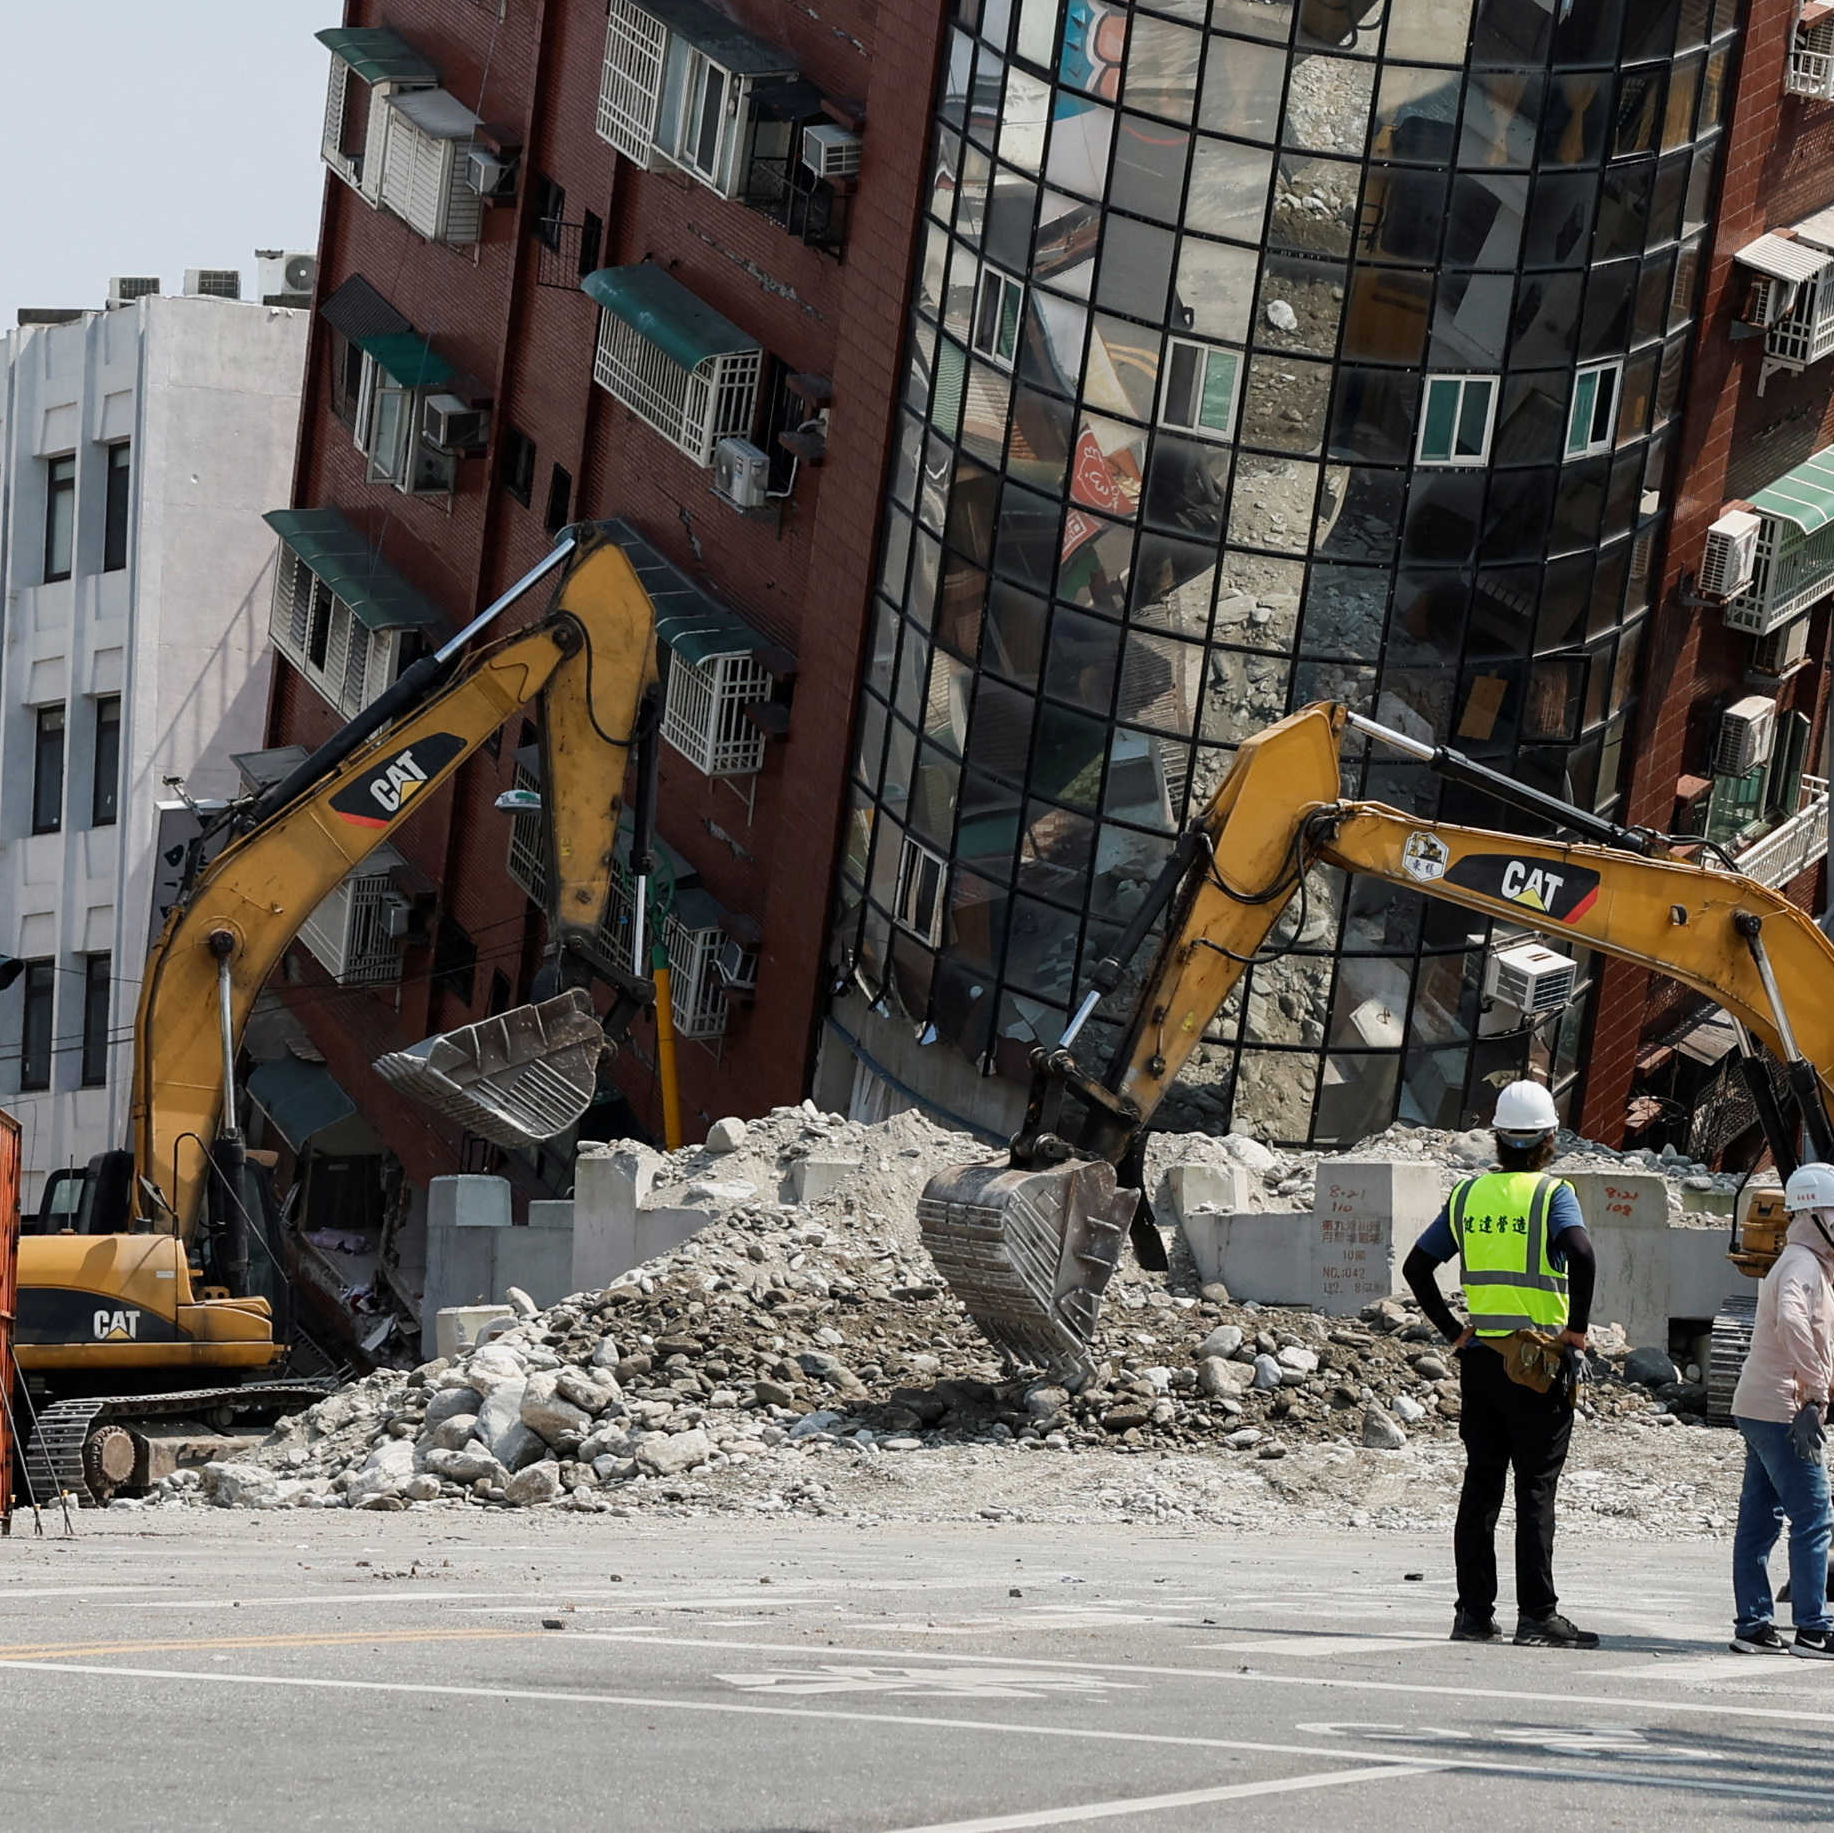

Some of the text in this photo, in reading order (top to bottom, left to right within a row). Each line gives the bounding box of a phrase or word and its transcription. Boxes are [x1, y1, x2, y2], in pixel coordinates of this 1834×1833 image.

[369, 750, 428, 812] CAT
[1501, 860, 1564, 912] CAT
[93, 1310, 141, 1340] CAT
